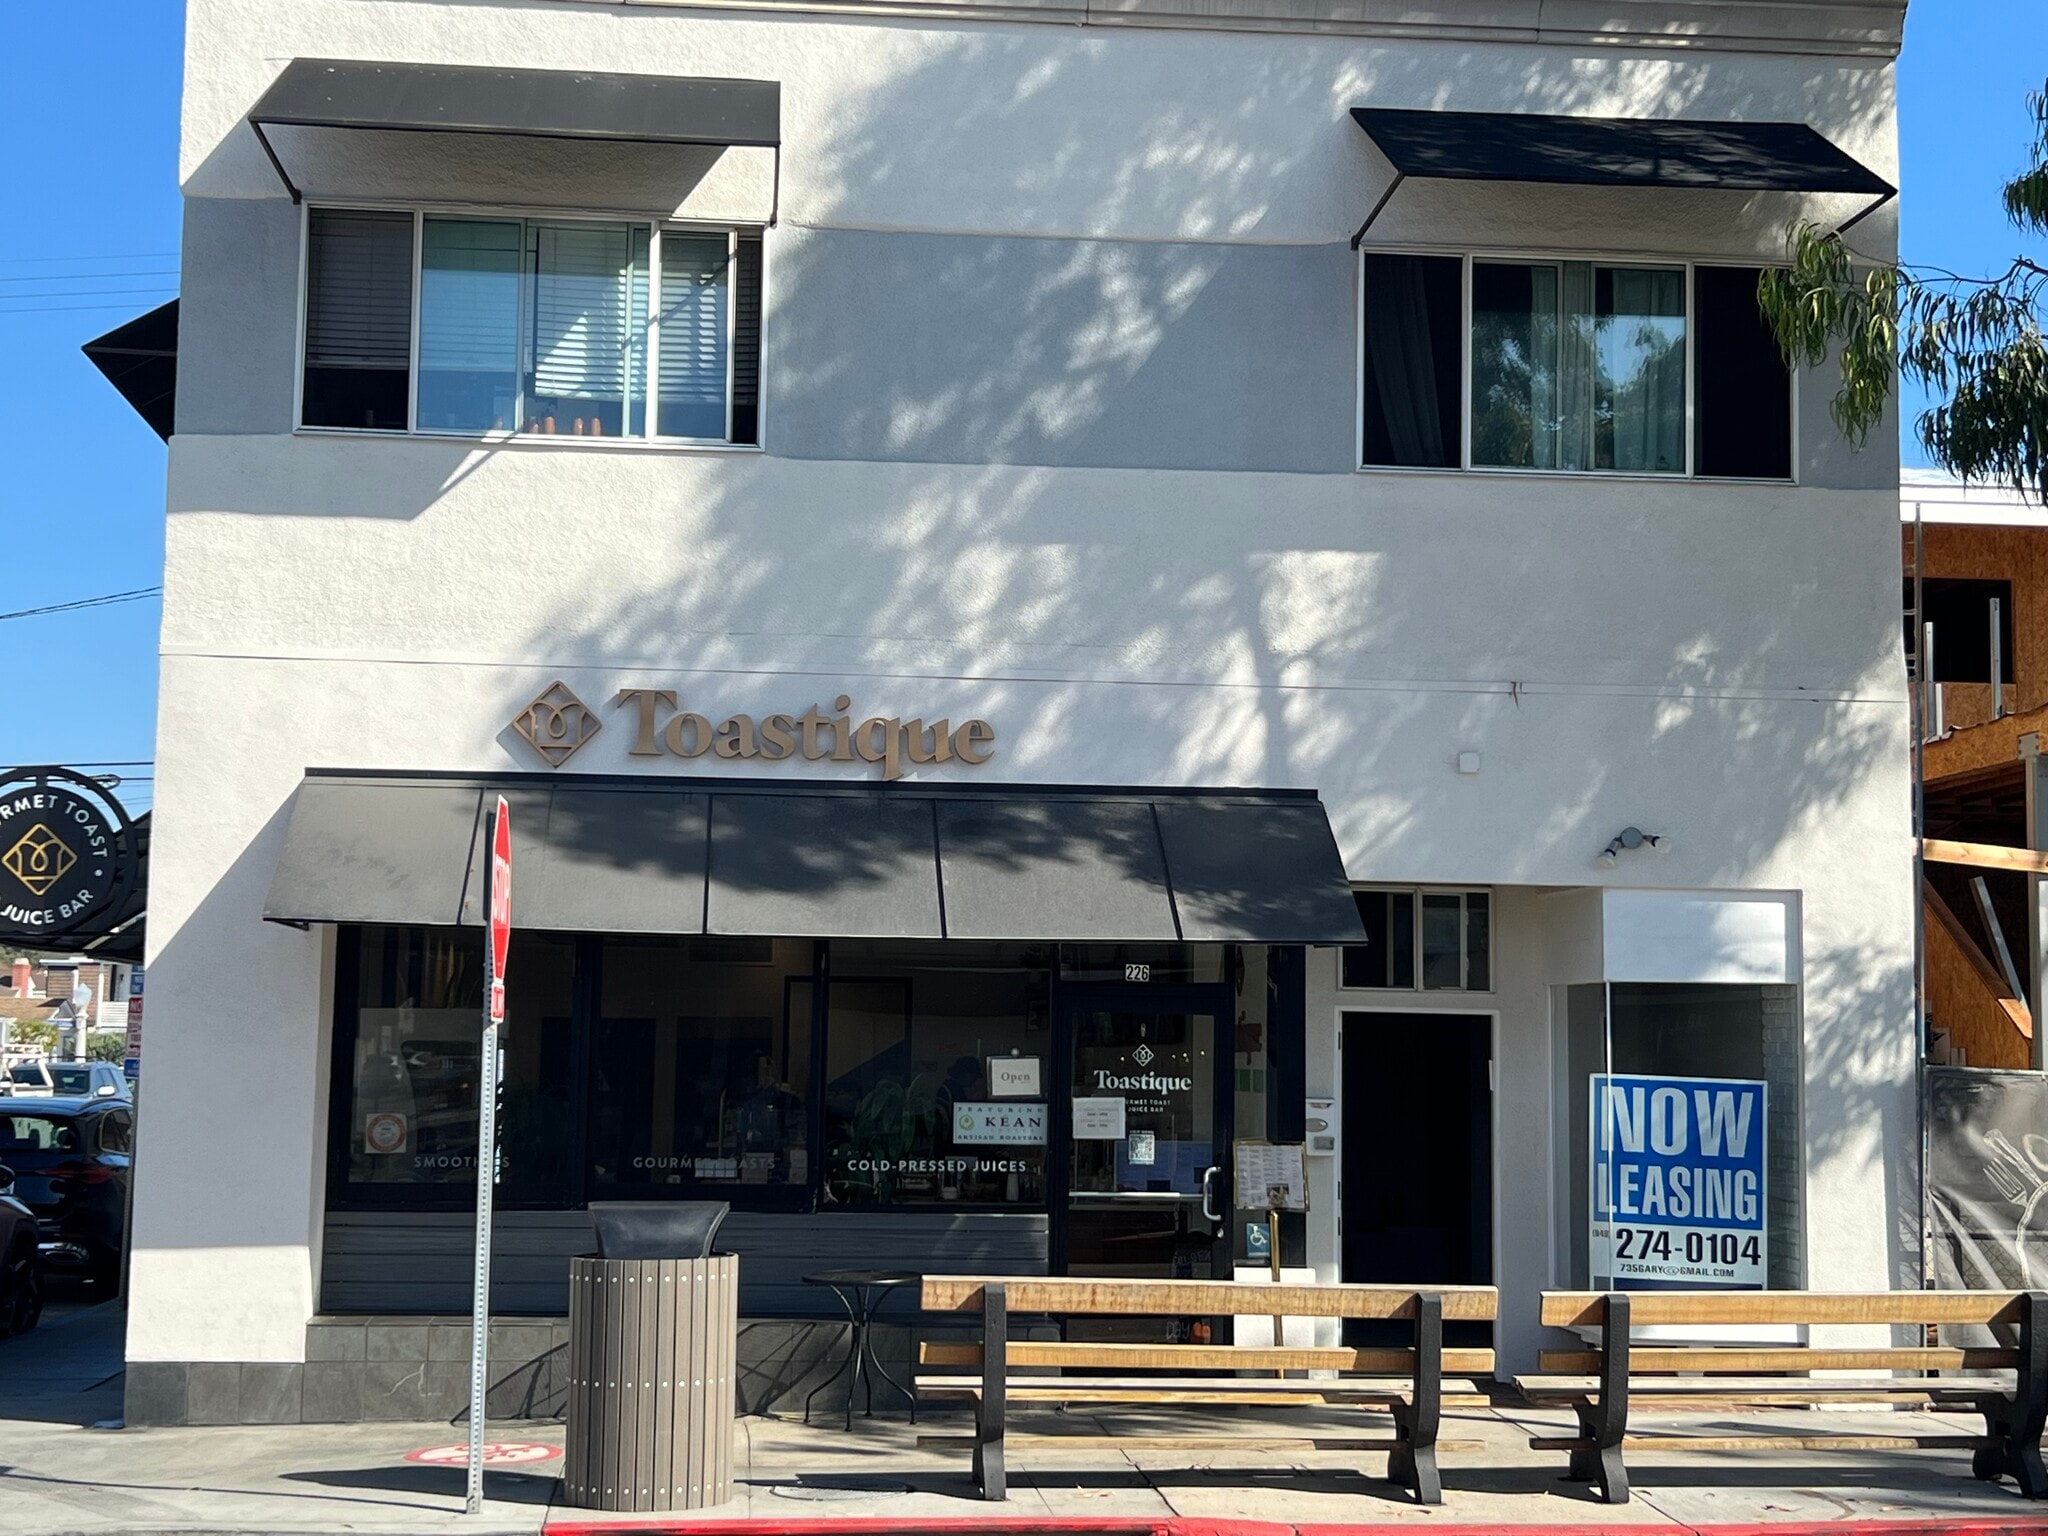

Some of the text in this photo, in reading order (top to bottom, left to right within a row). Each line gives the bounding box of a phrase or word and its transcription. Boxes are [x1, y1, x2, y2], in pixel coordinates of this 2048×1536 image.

[616, 688, 995, 782] Toastique
[0, 794, 108, 858] RMET TOAST
[0, 889, 94, 925] JUICE BAR
[1126, 965, 1149, 981] 226
[1001, 1072, 1031, 1084] Open
[1093, 1069, 1192, 1096] Toastique
[1601, 1085, 1754, 1159] NOW
[414, 1156, 510, 1168] SMOOTHS
[847, 1159, 1027, 1172] COLD-PRESSED JUICES
[1597, 1163, 1757, 1221] LEASING
[1616, 1228, 1762, 1265] 274-0104
